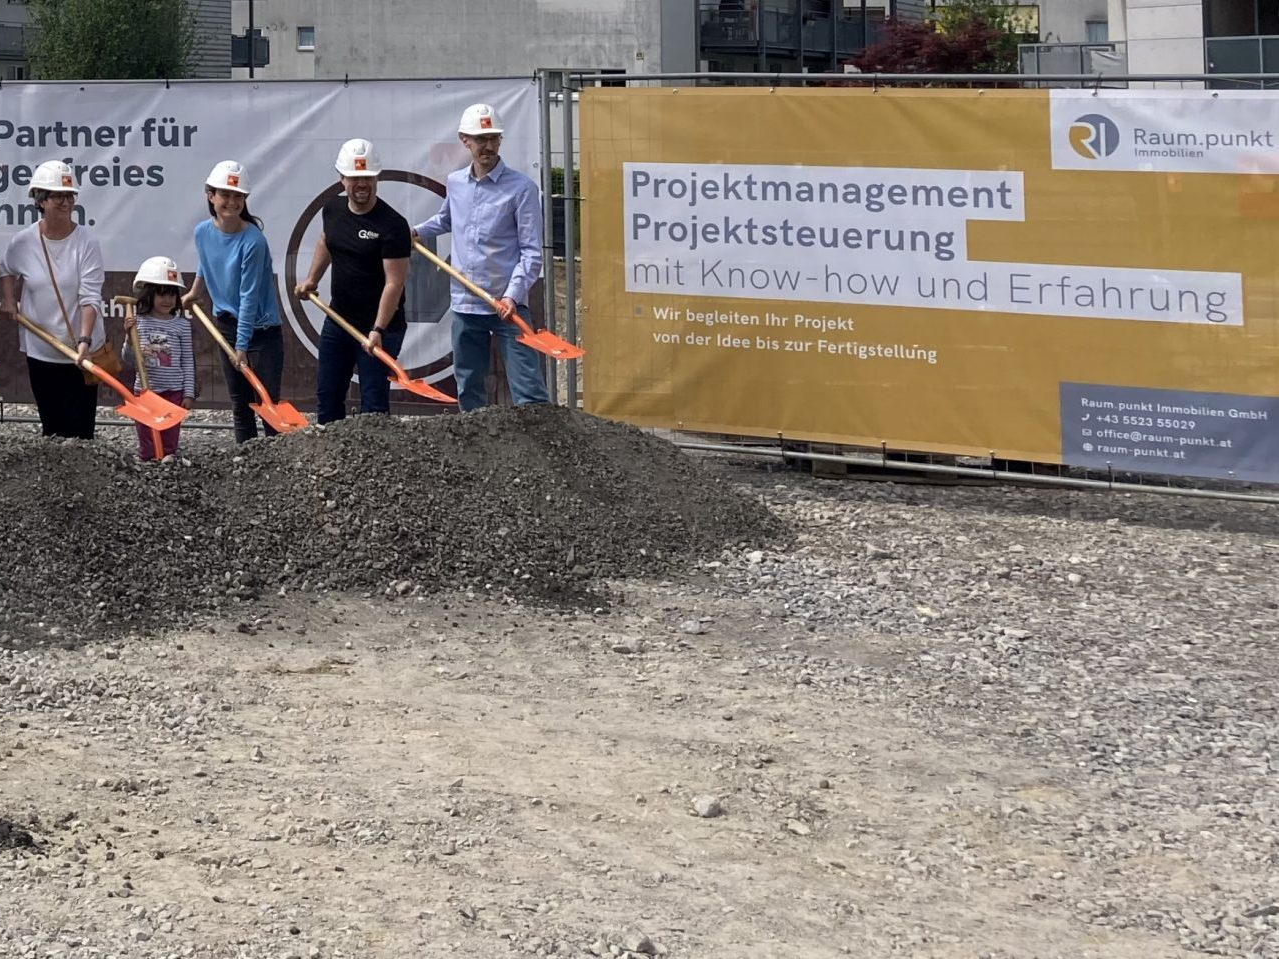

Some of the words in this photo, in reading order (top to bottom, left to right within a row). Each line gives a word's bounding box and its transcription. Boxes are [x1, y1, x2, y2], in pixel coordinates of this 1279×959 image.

[142, 117, 198, 147] für
[1133, 128, 1274, 150] Raum.punkt
[1134, 148, 1204, 158] Immobilien
[631, 170, 1013, 212] Projektmanagement
[632, 213, 955, 262] Projektsteuerung
[633, 258, 685, 286] mit
[701, 259, 900, 295] Know-how
[918, 272, 988, 302] und
[1009, 273, 1228, 323] Erfahrung
[652, 306, 681, 321] Wir
[686, 308, 760, 326] begleiten
[765, 313, 789, 328] Ihr
[794, 314, 855, 333] Projekt
[652, 332, 681, 345] von
[685, 331, 712, 346] der
[716, 334, 751, 349] Idee
[755, 336, 780, 351] bis
[784, 340, 813, 353] zur
[817, 339, 938, 364] Fertigstellung
[1081, 397, 1154, 413] Raum.punkt
[1157, 403, 1225, 418] Immobilien
[1228, 408, 1268, 420] GmbH
[1096, 414, 1119, 424] +43
[1123, 416, 1153, 427] 5523
[1157, 418, 1196, 430] 55029
[1096, 429, 1232, 448] office@raum-punkt.at
[1097, 444, 1186, 459] raum-punkt.at
